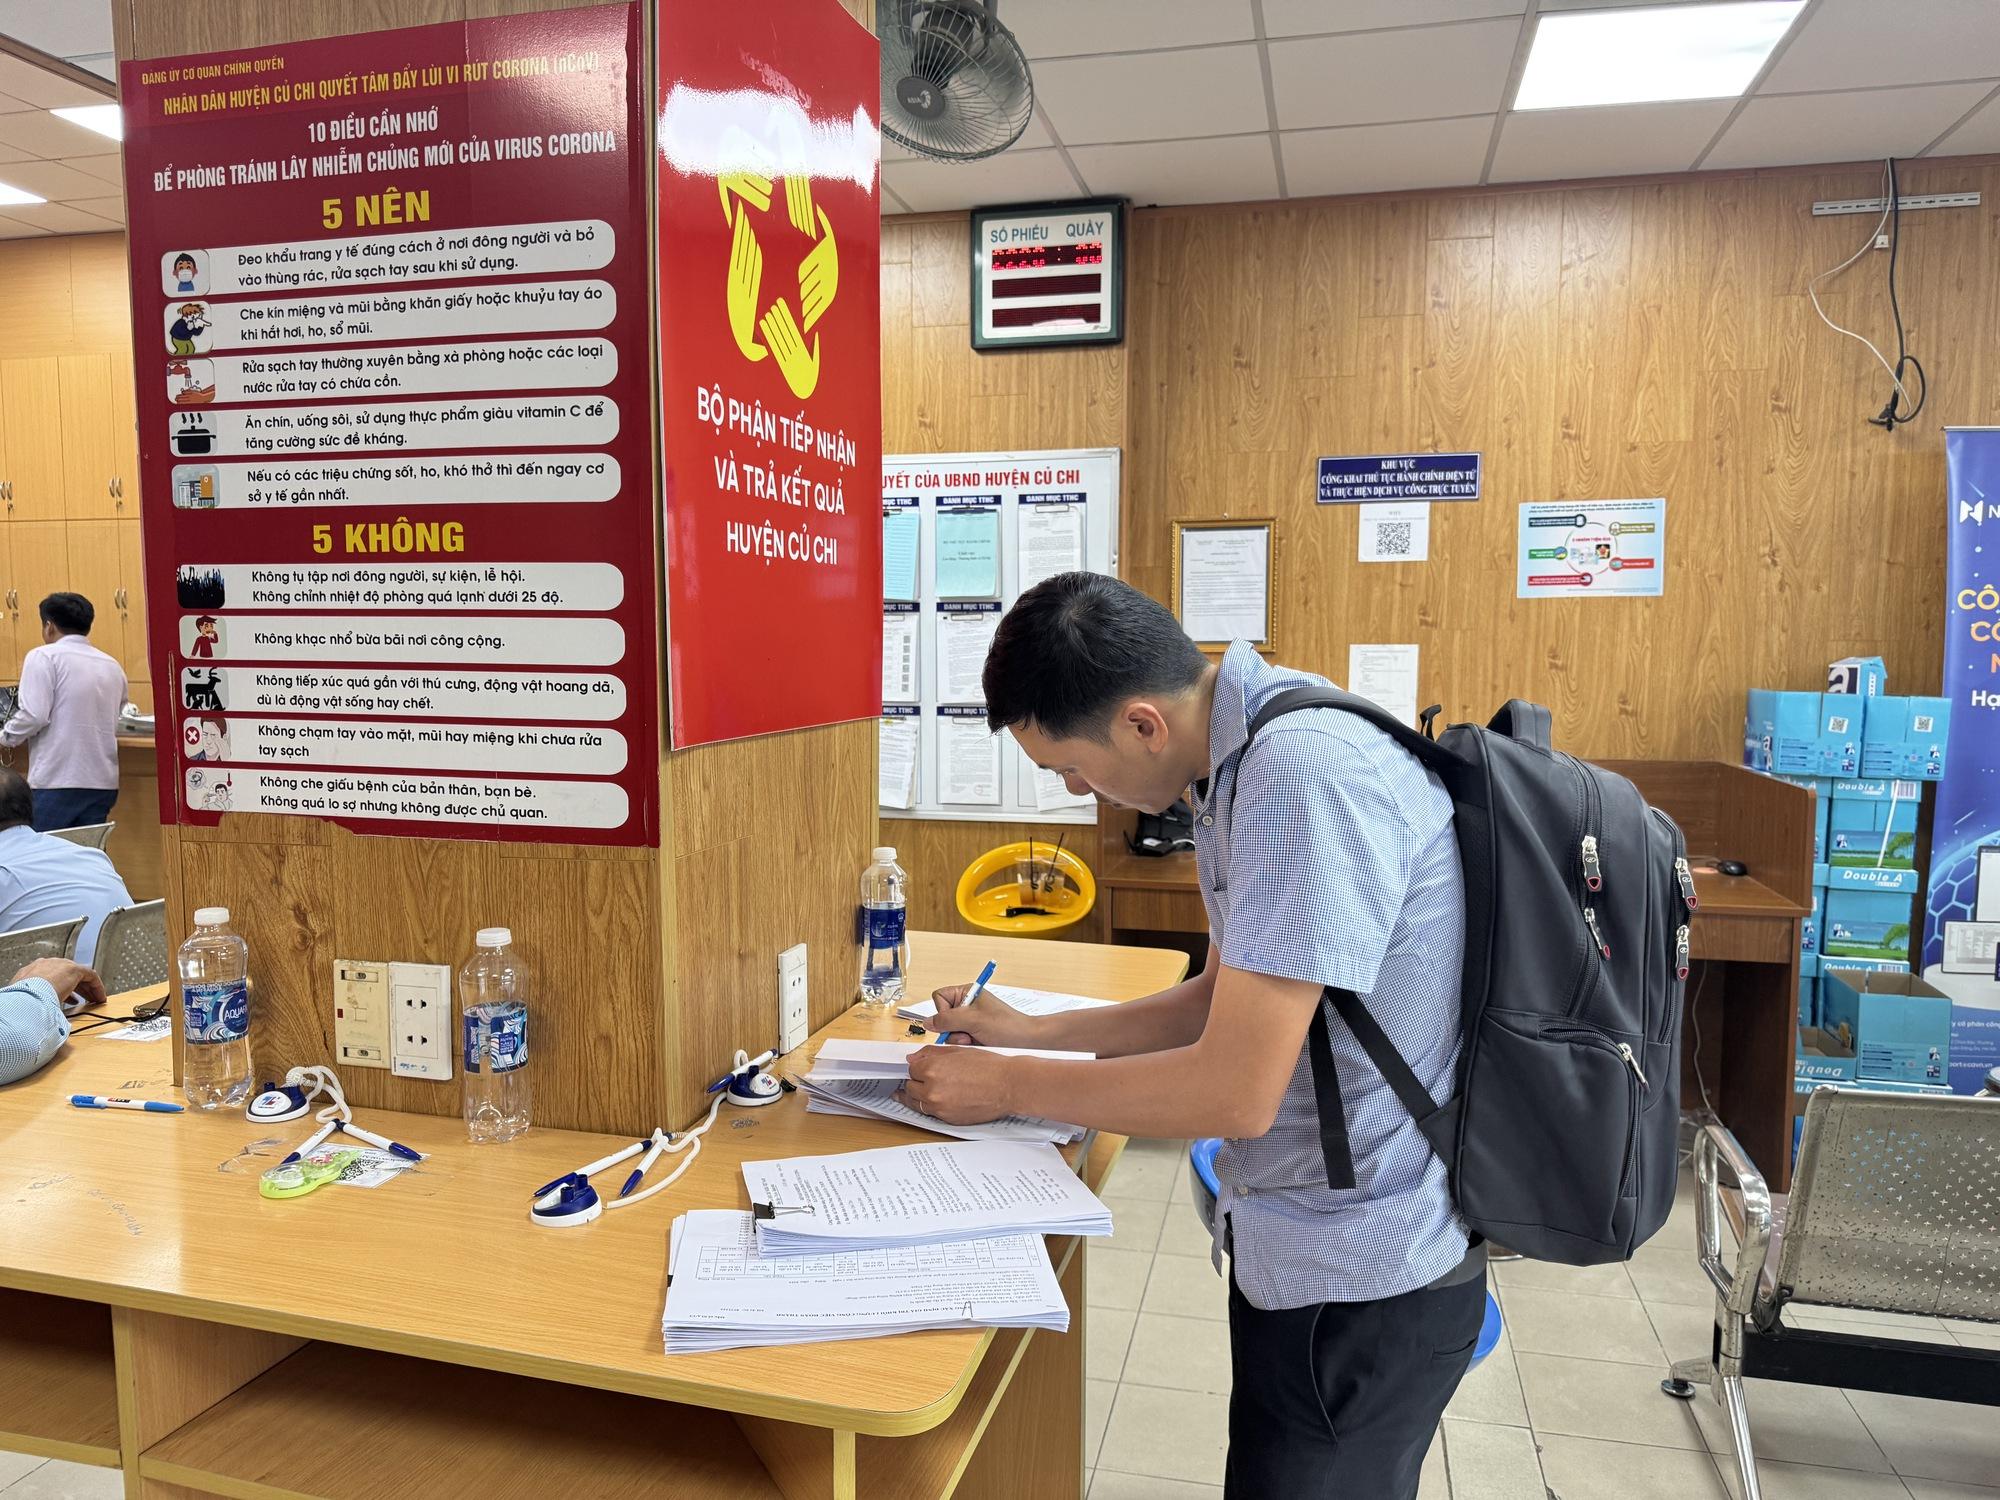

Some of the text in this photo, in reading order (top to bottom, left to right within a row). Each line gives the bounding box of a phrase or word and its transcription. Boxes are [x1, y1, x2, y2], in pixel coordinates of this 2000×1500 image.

[164, 92, 198, 115] NHÂN
[201, 89, 226, 111] DÂN
[229, 84, 270, 110] HUYỆN
[274, 79, 290, 103] CỦ
[294, 81, 315, 101] CHI
[319, 71, 358, 100] QUYẾT
[361, 70, 389, 93] TÂM
[393, 66, 418, 90] ĐẨY
[422, 63, 442, 87] LÙI
[446, 65, 459, 84] VI
[463, 58, 489, 82] RÚT
[492, 55, 549, 80] CORONA
[308, 105, 439, 143] 10 ĐIỀU CẦN NHỚ
[153, 129, 617, 192] ĐỂ PHÒNG TRÁNH LÂY NHIỄM CHỦNG MỚI CỦA VIRUS CORONA
[323, 186, 430, 229] 5 NÊN
[238, 226, 595, 266] Đeo khẩu trang y tế đúng cách ở nơi đông người và bỏ
[238, 255, 518, 286] vào thùng rác, rửa sạch tay sau khi sử dụng.
[697, 383, 856, 471] BỘ PHẬN TIẾP NHẬN
[714, 450, 845, 516] VÀ TRẢ KẾT QUẢ
[915, 470, 940, 488] CỦA
[945, 473, 980, 488] UBND
[985, 469, 1030, 489] HUYỆN
[1034, 466, 1052, 485] CỦ
[1056, 470, 1080, 484] CHI
[1343, 474, 1363, 484] KHAI
[313, 516, 464, 554] 5 KHÔNG
[727, 519, 785, 566] HUYỆN
[788, 523, 810, 562] CỦ
[814, 535, 838, 565] CHI
[254, 630, 505, 649] Không khạc nhổ bừa bãi nơi công cộng.
[1836, 781, 1885, 791] Double A
[261, 795, 547, 820] Không quá lo sợ nhưng không được chủ quan.
[1843, 870, 1903, 883] Double A
